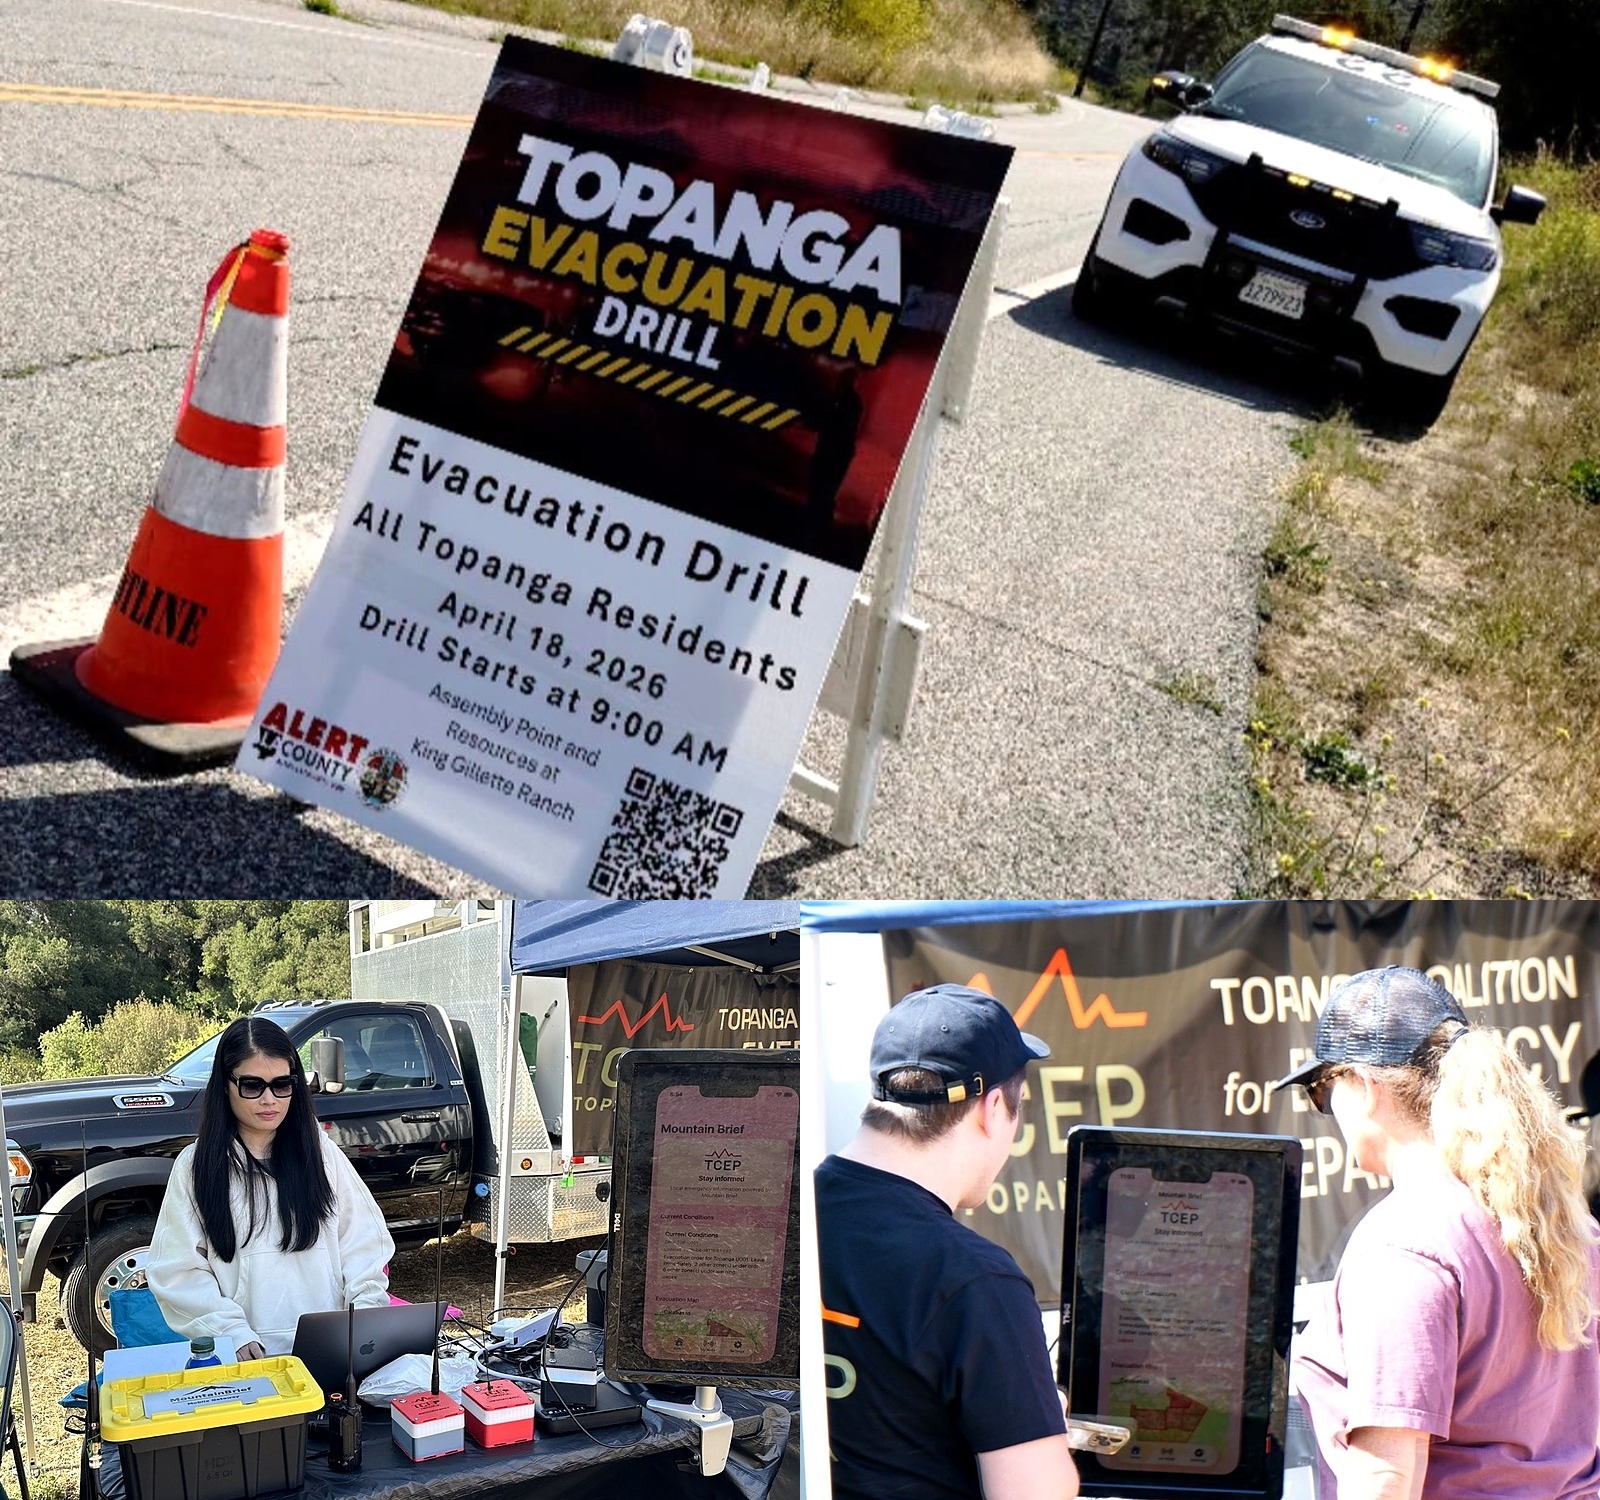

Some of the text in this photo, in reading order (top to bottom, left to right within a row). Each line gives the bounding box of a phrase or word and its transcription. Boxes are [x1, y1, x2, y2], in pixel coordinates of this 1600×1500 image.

[518, 134, 901, 304] TOPANGA
[482, 205, 892, 366] EVACUATION
[593, 296, 721, 370] DRILL
[390, 435, 809, 618] Evacuation Drill
[114, 561, 208, 649] TLINE
[353, 502, 798, 691] All Topanga Residents
[437, 591, 669, 698] April 18, 2026
[360, 605, 729, 773] Drill Starts at 9:00 AM
[262, 702, 370, 764] ALERT
[428, 683, 601, 767] Assembly Point and
[446, 721, 562, 783] Resources at
[281, 739, 354, 782] COUNTY
[411, 738, 450, 771] King
[450, 756, 515, 796] Gillette
[517, 783, 576, 822] Ranch
[719, 1008, 799, 1031] TOPANGA
[573, 1096, 617, 1112] TOP
[1223, 1071, 1279, 1116] for
[661, 1124, 745, 1134] Mountain Brief
[698, 1175, 745, 1183] Stay informed
[705, 1160, 742, 1171] TCEP
[1155, 1228, 1169, 1236] Stay
[1160, 1211, 1199, 1225] TCEP
[170, 1387, 252, 1402] MountainBrief
